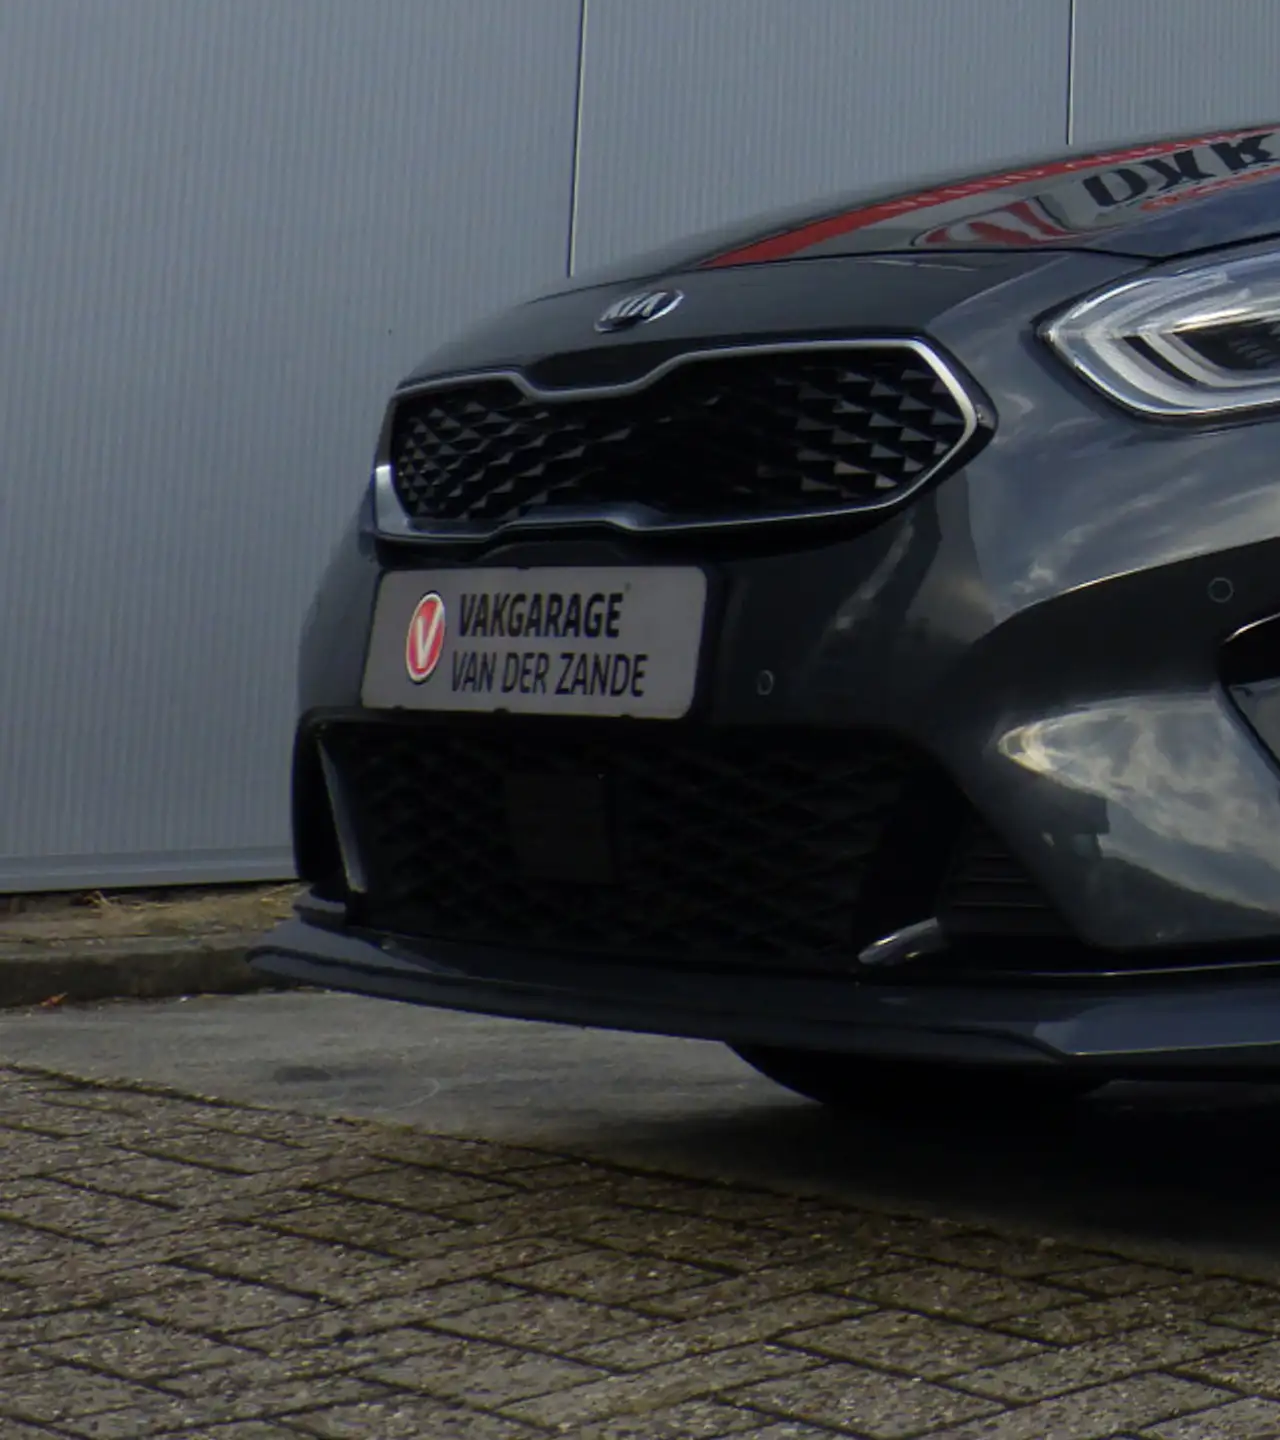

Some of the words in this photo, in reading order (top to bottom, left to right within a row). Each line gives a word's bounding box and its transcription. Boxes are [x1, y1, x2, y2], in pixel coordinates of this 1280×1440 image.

[458, 592, 624, 638] VAKGARAGE
[451, 650, 498, 693] VAN
[501, 652, 549, 695] DER
[554, 653, 649, 698] ZANDE
